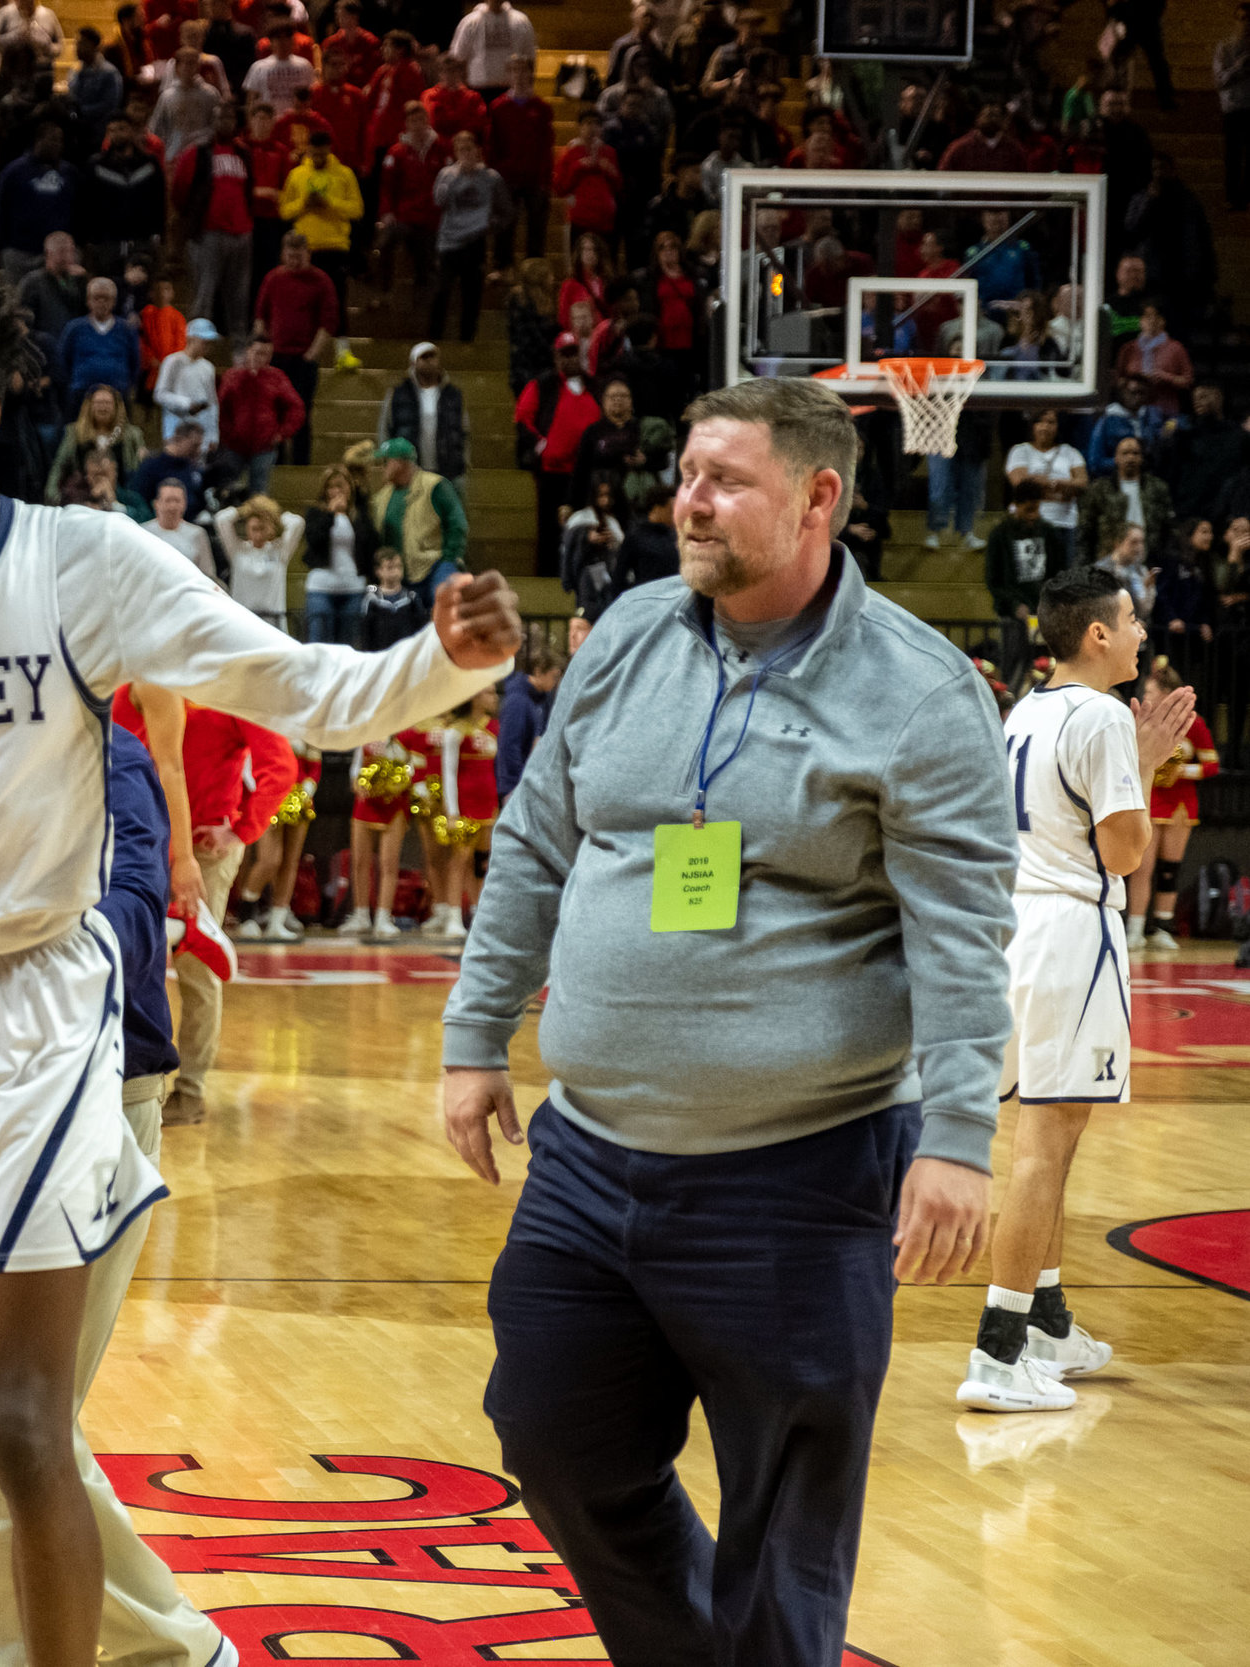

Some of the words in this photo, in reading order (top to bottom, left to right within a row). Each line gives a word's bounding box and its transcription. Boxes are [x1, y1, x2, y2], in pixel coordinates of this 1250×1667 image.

[1007, 734, 1032, 832] 1
[681, 870, 714, 879] NJSIAA
[683, 885, 711, 893] Coach
